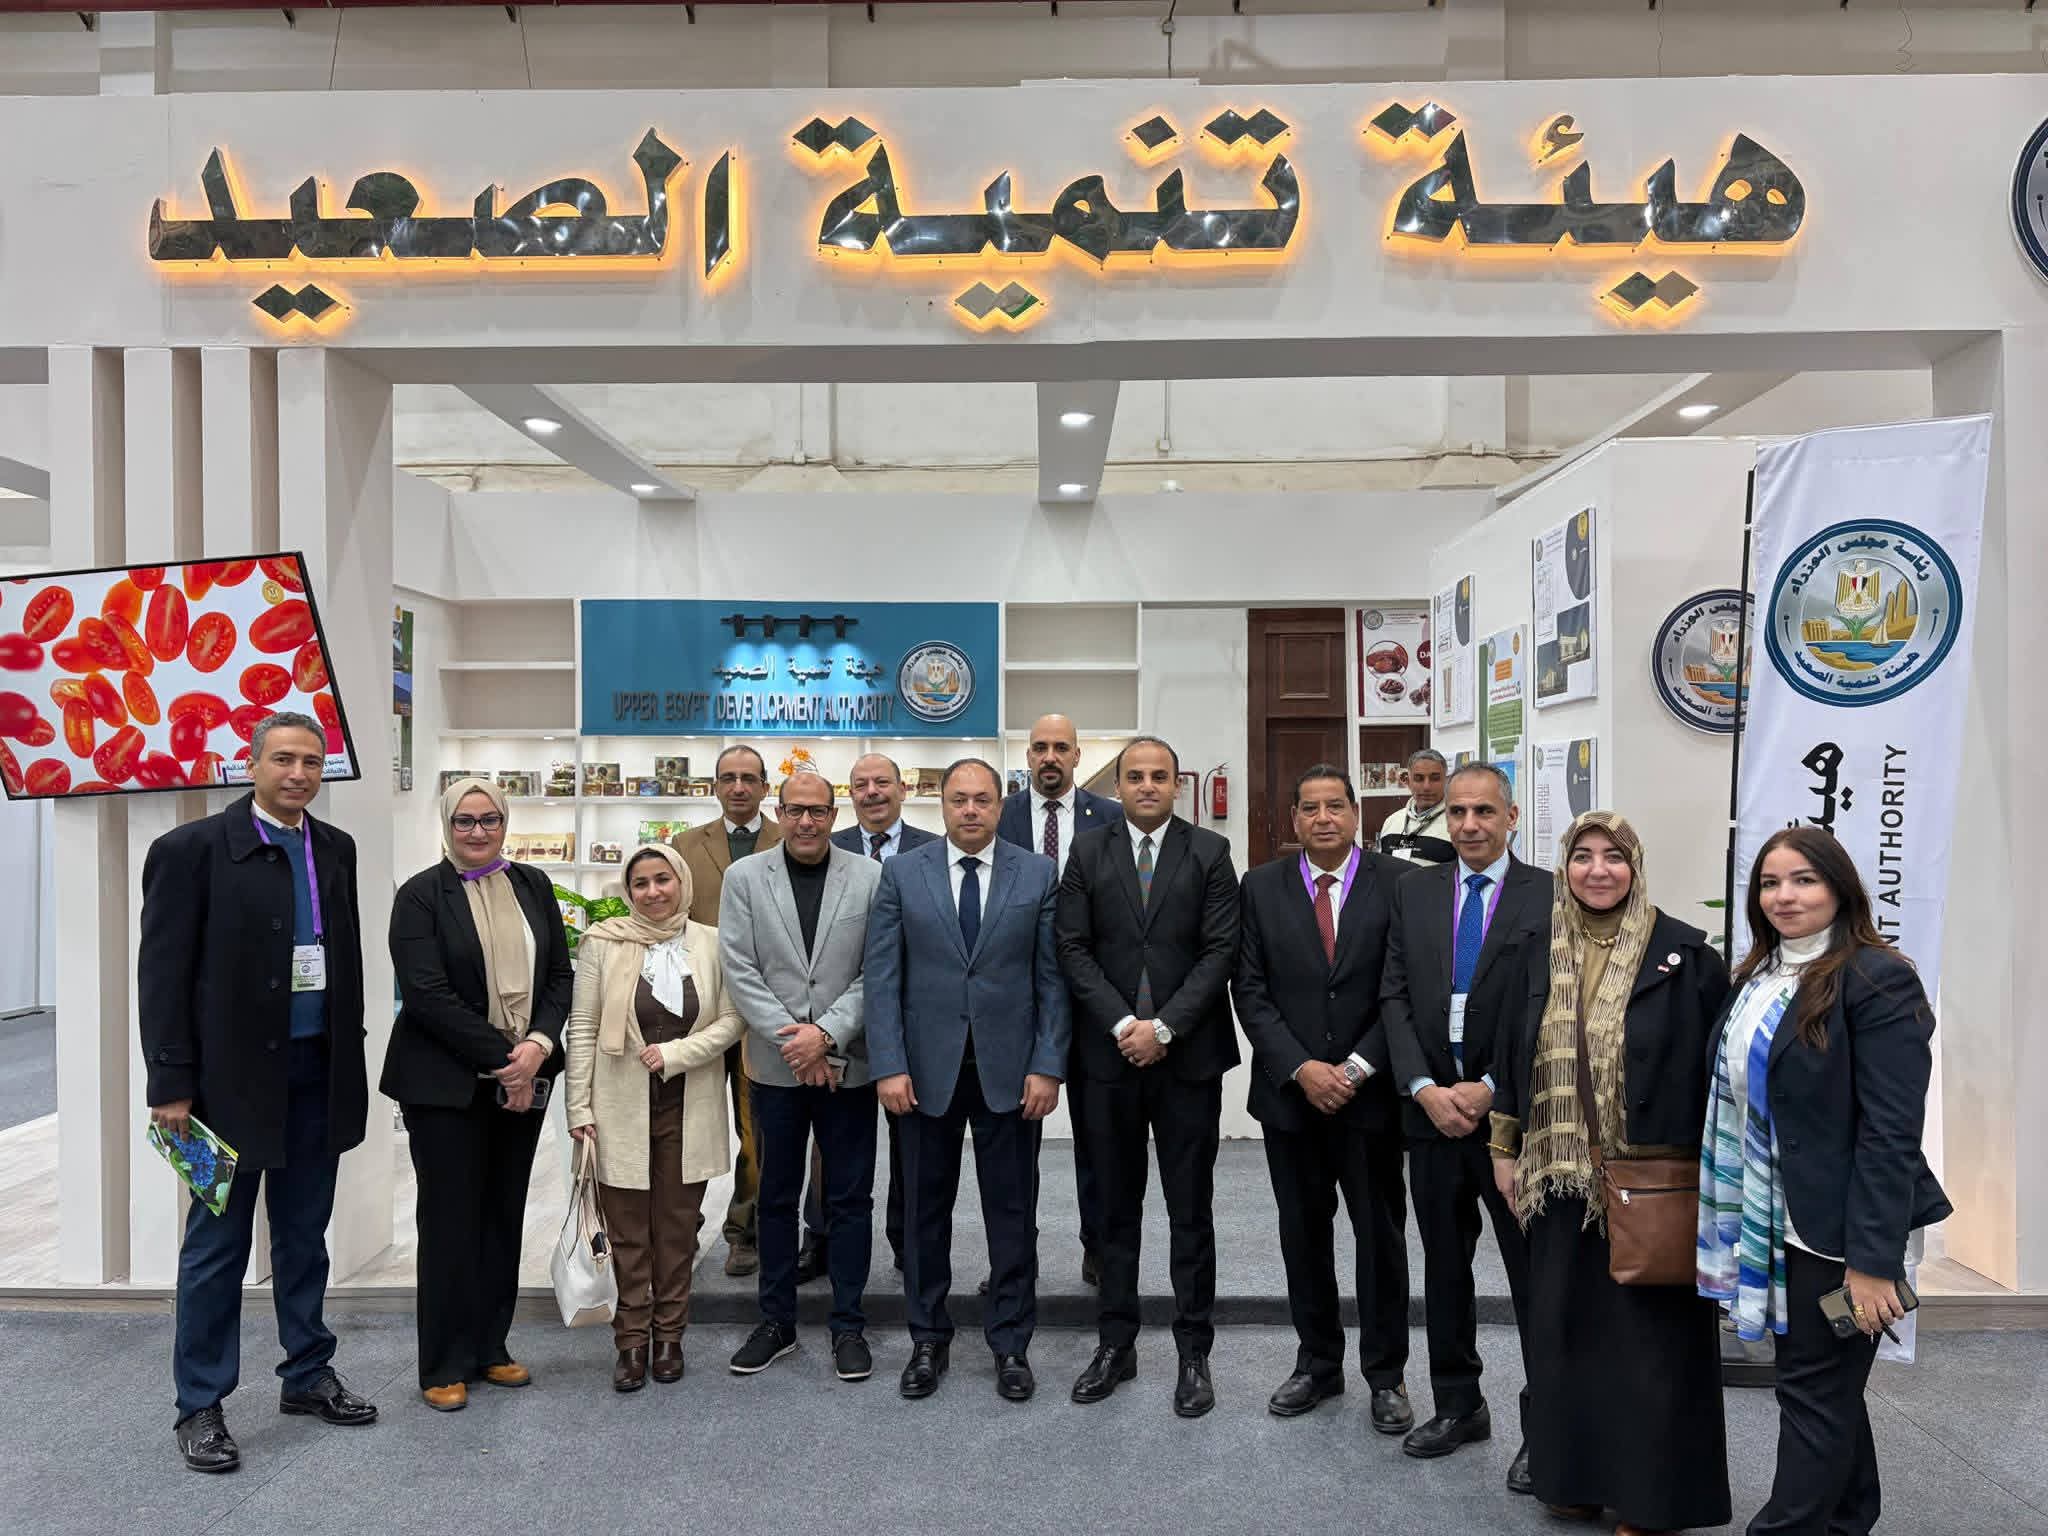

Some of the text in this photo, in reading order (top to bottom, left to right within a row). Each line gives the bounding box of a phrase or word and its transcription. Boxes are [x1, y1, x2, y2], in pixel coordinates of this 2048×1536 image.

[149, 102, 1806, 324] هيئة تنمية الصعيد
[1791, 533, 1931, 596] رئاسة مجلس الوزراء
[1673, 607, 1705, 643] الوزراء
[1794, 651, 1920, 690] هيئة تنمية الصعيد
[614, 691, 659, 720] UPPER
[824, 693, 894, 721] AUTHORITY
[1673, 686, 1713, 716] الصعيد
[1878, 744, 1907, 907] AUTHORITY
